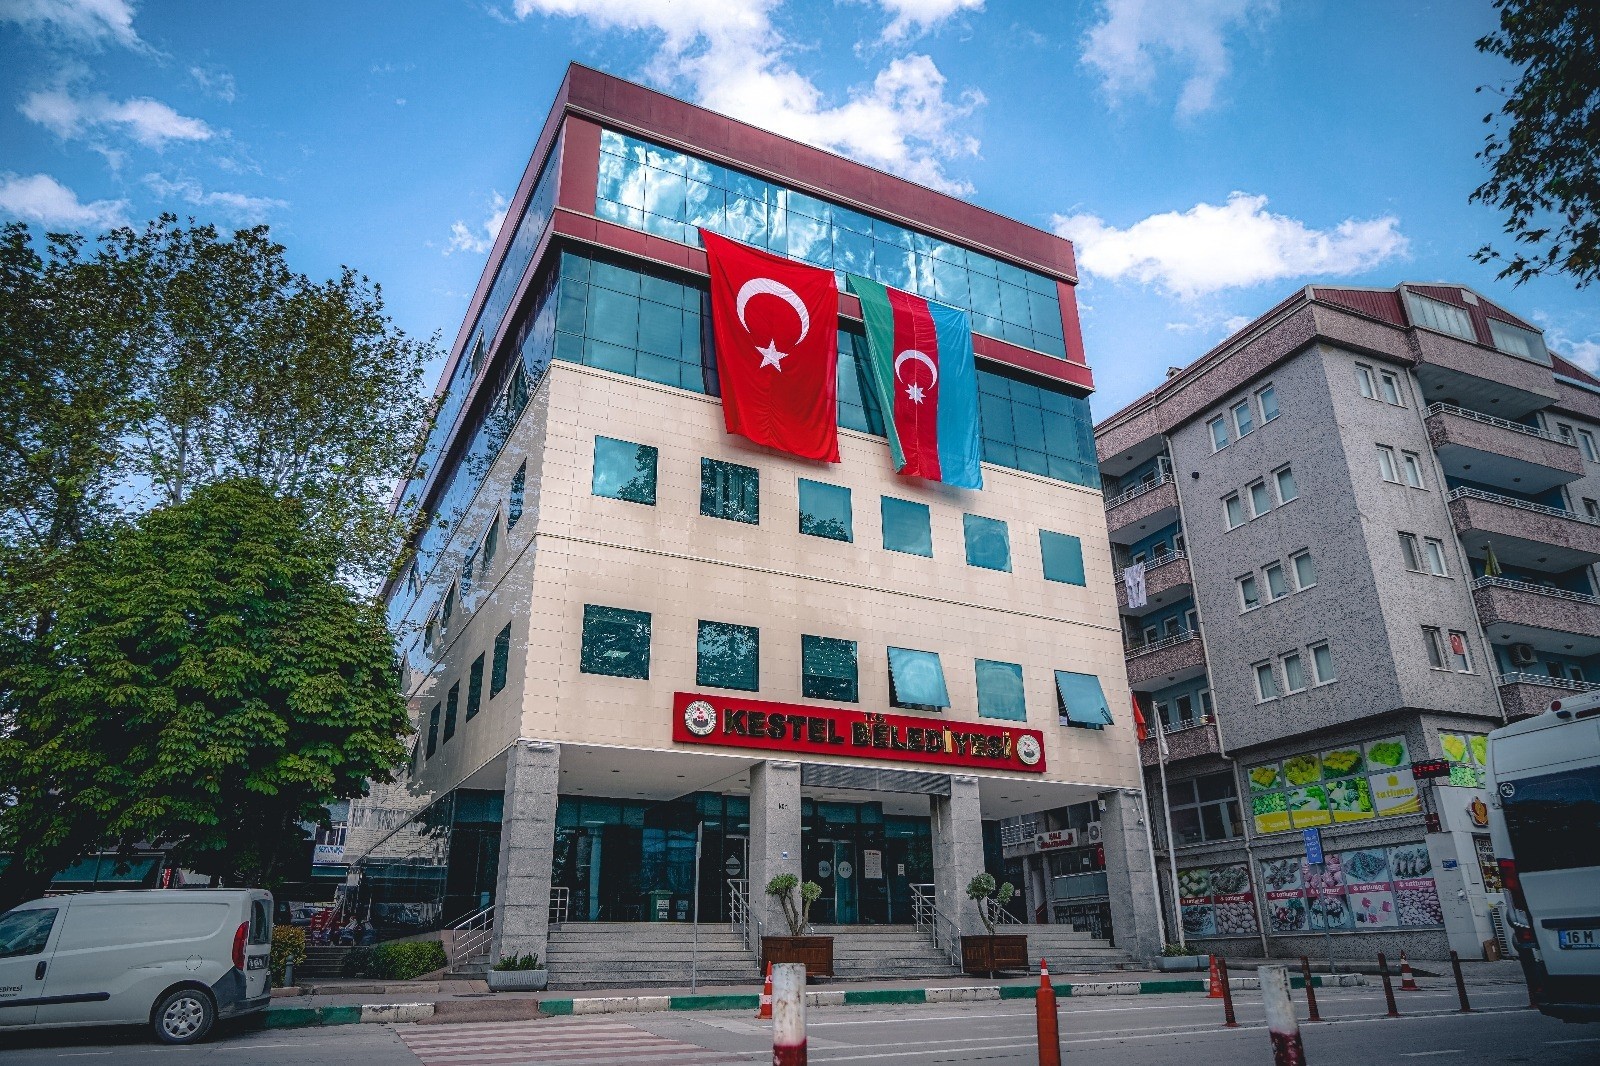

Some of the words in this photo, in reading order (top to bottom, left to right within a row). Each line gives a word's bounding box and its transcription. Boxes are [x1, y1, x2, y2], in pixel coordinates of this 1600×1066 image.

[722, 708, 845, 744] KESTEL
[851, 721, 1012, 759] BELEDİYESİ
[1566, 931, 1580, 943] 16
[1583, 930, 1594, 943] M
